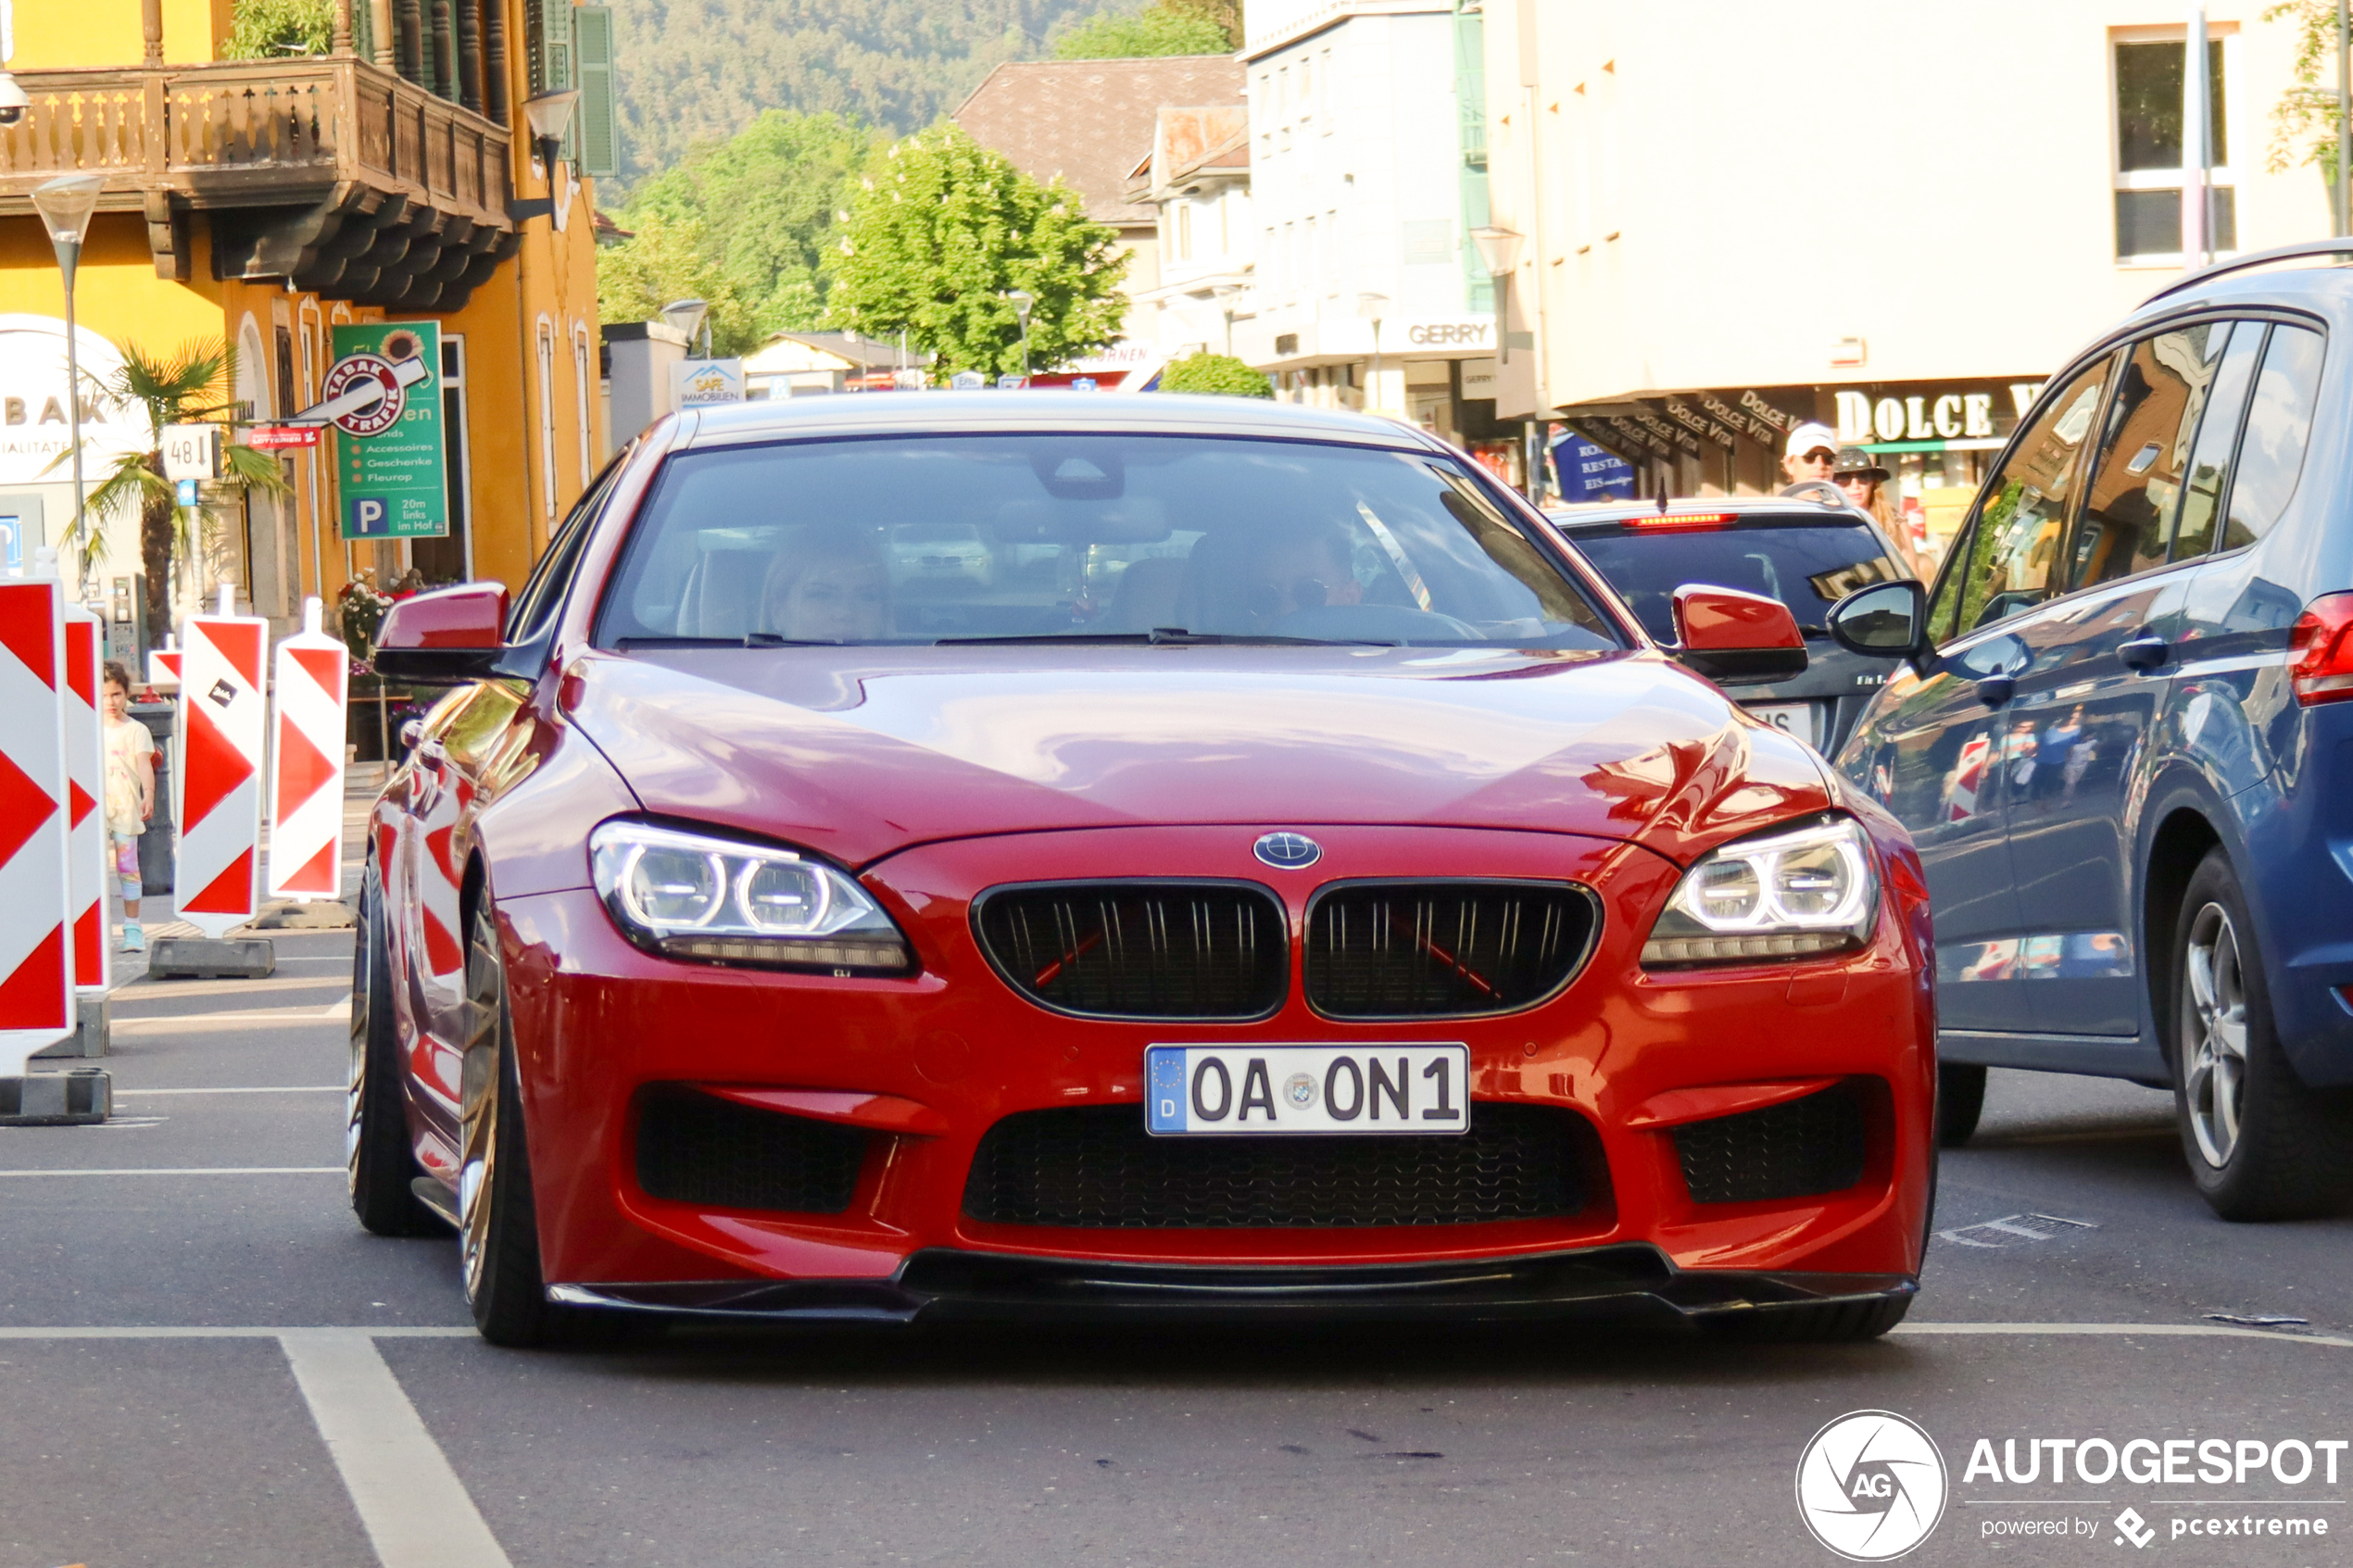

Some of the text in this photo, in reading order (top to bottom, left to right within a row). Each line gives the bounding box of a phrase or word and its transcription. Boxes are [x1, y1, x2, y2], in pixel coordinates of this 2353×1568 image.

[1409, 323, 1487, 345] GERRY
[329, 360, 384, 395] TABAK
[696, 378, 724, 392] SAFE
[682, 392, 739, 402] IMMOBILIEN
[347, 388, 399, 431] TRAFIK
[1741, 389, 1786, 427] DOLCE
[1834, 390, 1992, 442] DOLCE
[1667, 404, 1708, 432] DOLCE
[252, 436, 302, 445] LOTTERIEN
[366, 444, 434, 453] Accessoires
[171, 440, 193, 465] 48
[367, 458, 433, 468] Geschenke
[1581, 458, 1628, 473] RESTA
[367, 473, 413, 483] Fleurop
[360, 499, 426, 533] P 20m
[402, 510, 426, 520] links
[397, 521, 411, 531] im
[414, 521, 433, 531] Hof
[1161, 1099, 1176, 1118] D
[1191, 1056, 1277, 1122] OA
